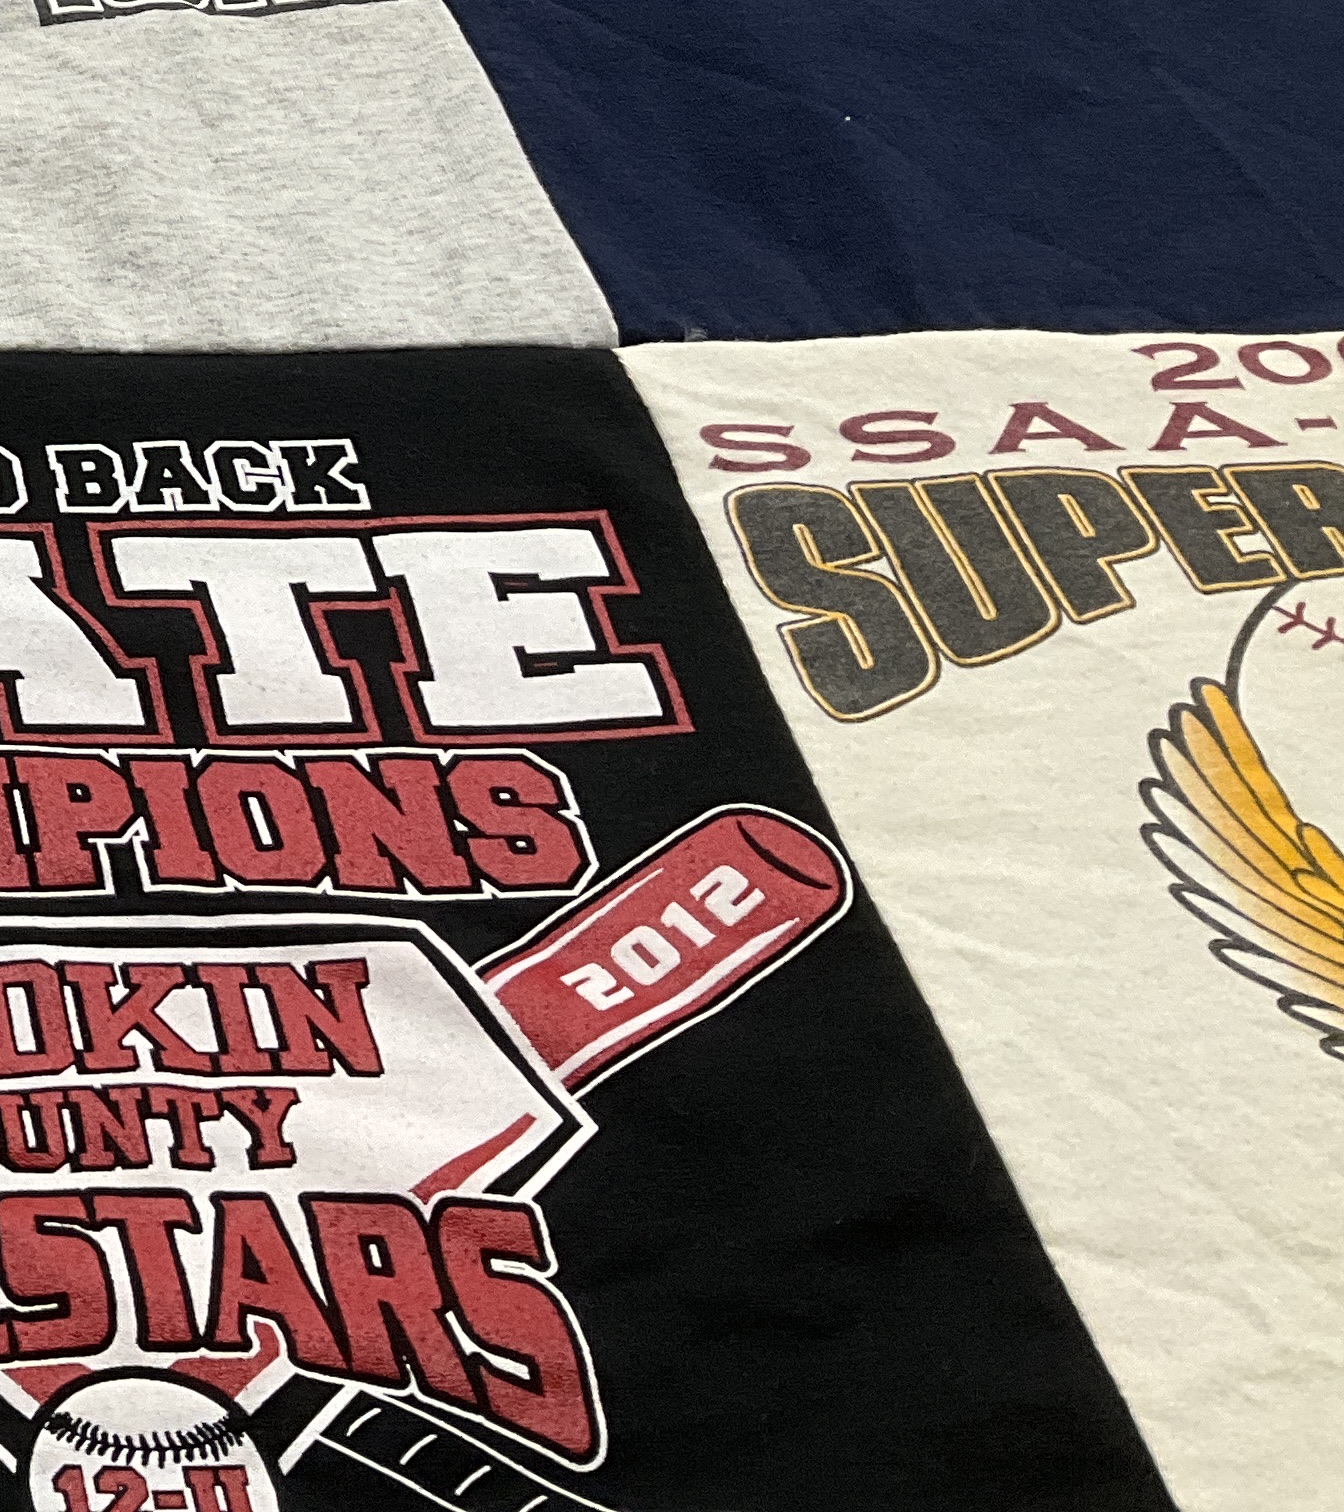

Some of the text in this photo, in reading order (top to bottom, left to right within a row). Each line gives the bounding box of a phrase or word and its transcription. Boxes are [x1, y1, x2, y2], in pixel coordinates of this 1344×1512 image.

[1131, 340, 1344, 392] 20
[47, 437, 370, 513] BACK
[555, 863, 769, 1014] 2012
